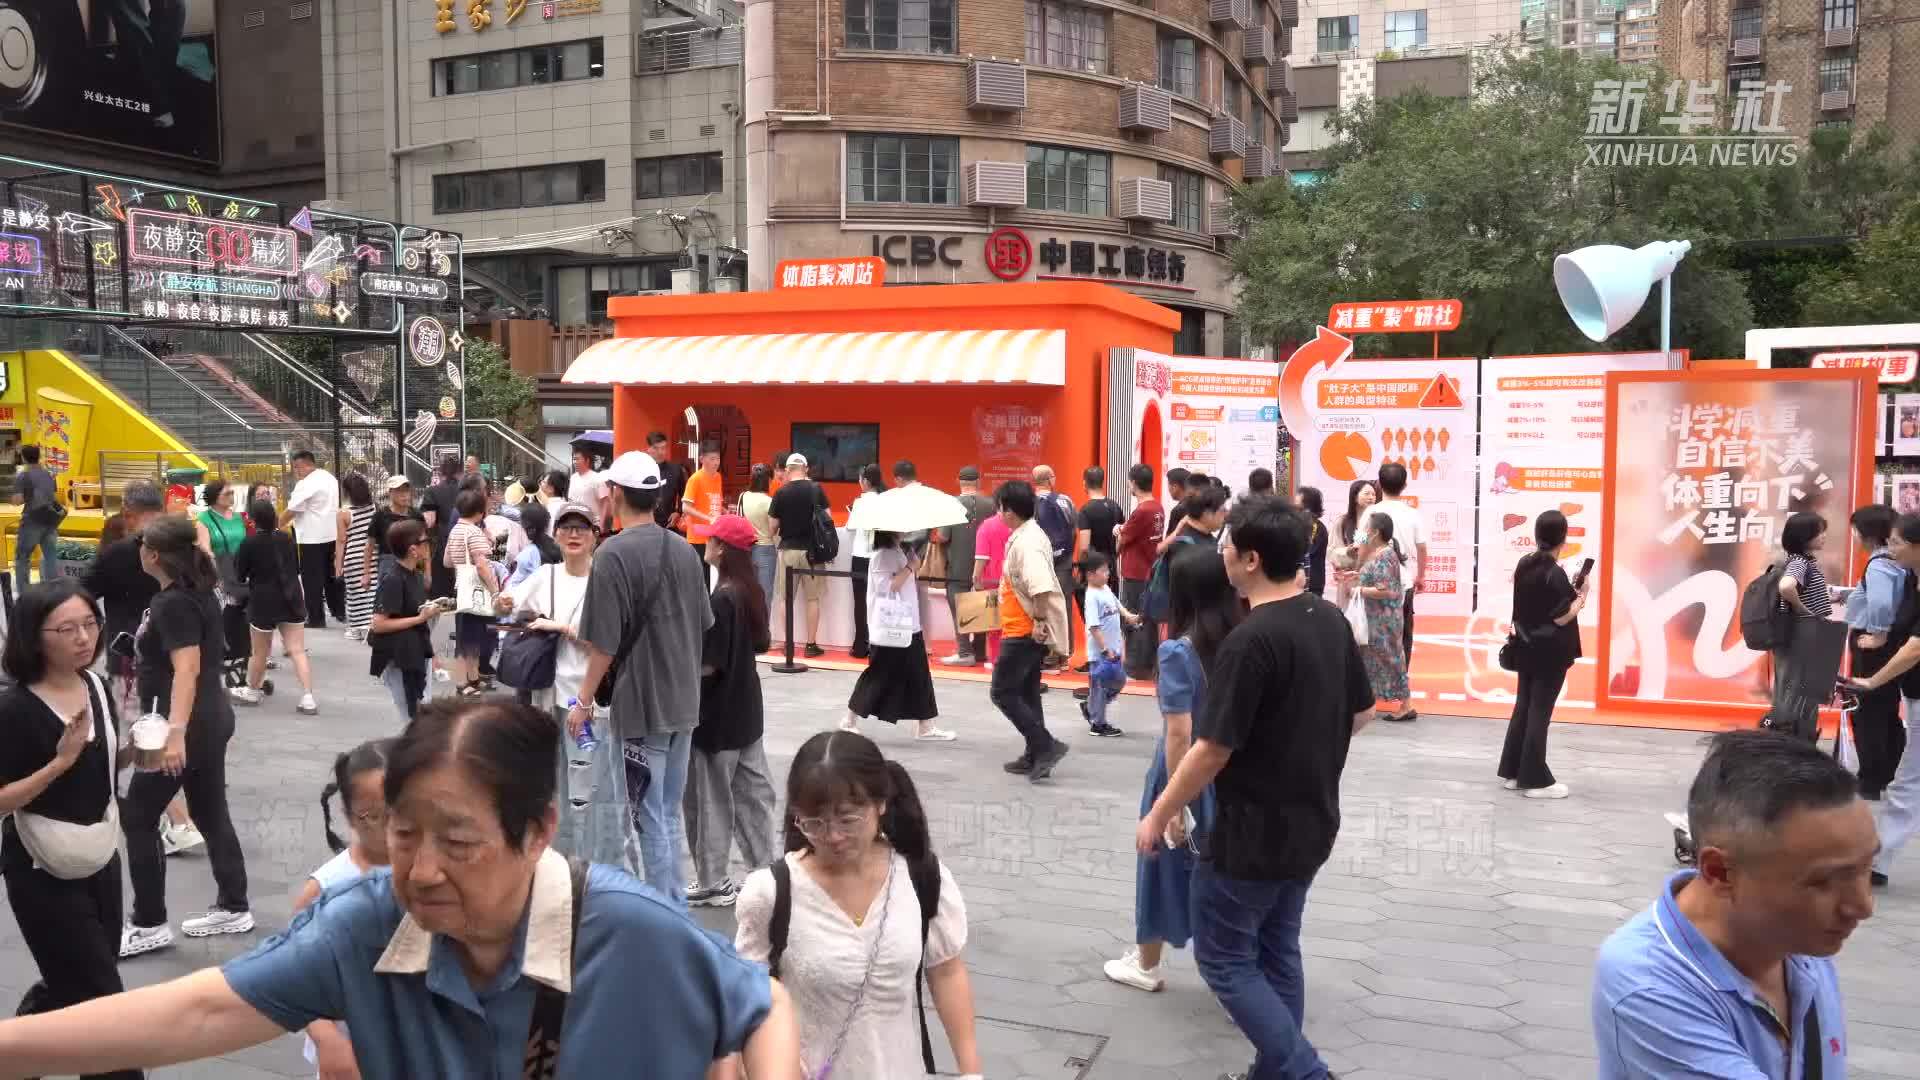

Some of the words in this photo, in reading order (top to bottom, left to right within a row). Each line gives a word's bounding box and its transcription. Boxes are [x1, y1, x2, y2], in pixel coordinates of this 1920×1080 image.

[872, 234, 963, 267] ICBC
[1039, 237, 1186, 283] 中国工商银行
[221, 280, 277, 296] SHANGHAI
[783, 262, 874, 287] 体脂聚测站
[1661, 472, 1807, 511] 体重向下
[1657, 508, 1800, 547] 人生向
